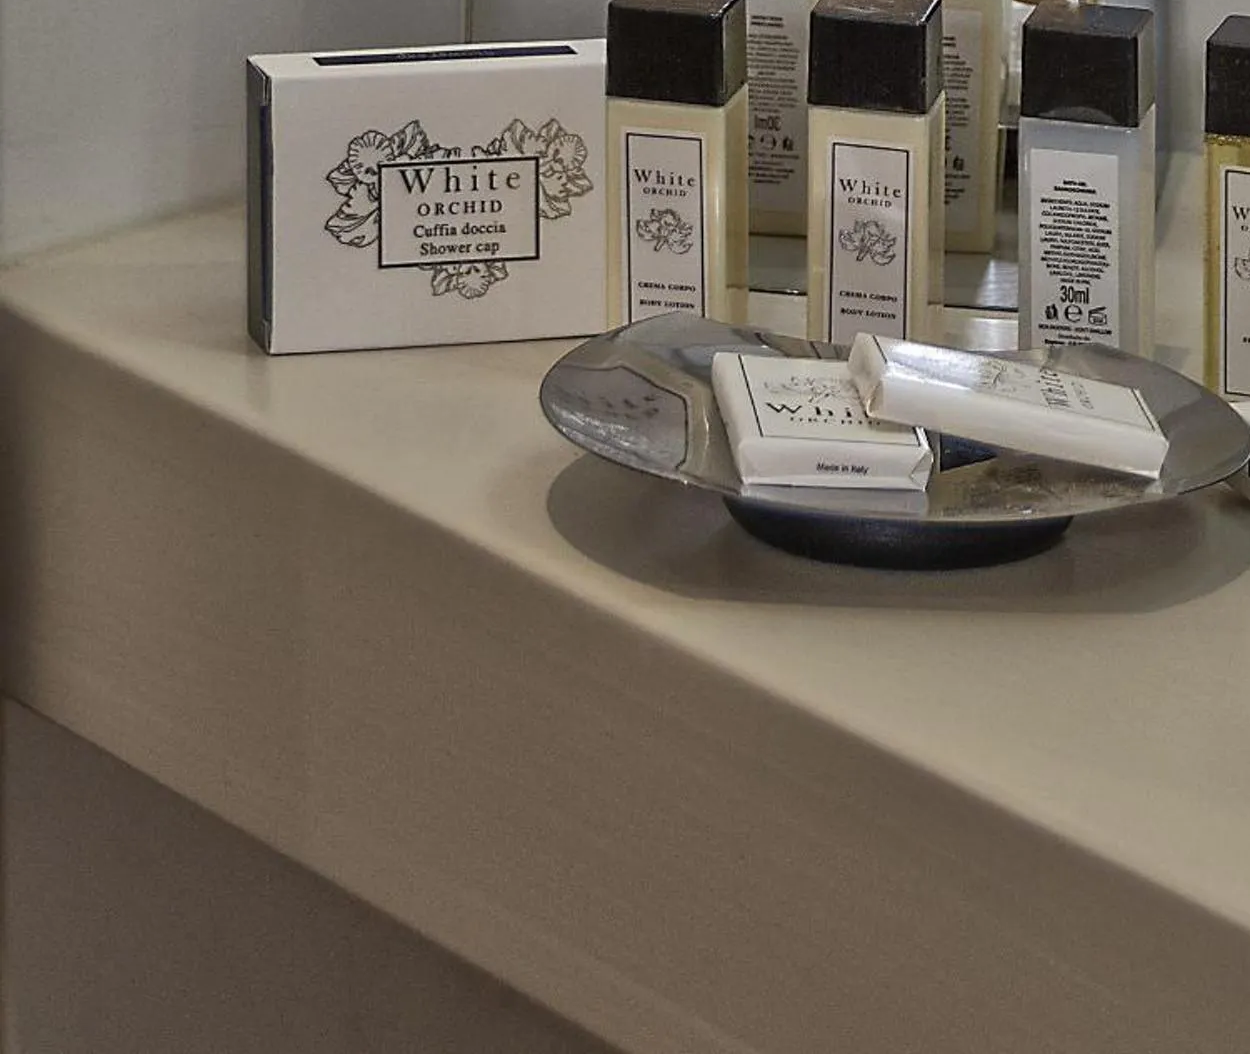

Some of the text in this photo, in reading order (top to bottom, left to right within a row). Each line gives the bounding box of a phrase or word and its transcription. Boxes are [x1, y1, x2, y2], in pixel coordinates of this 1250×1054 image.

[400, 166, 521, 194] White
[633, 168, 697, 187] White
[642, 186, 688, 197] ORCHID
[839, 178, 901, 198] White
[417, 200, 503, 217] ORCHID
[847, 197, 892, 208] ORCHID
[413, 222, 506, 238] Cuffia doccia
[420, 241, 500, 256] Shower cap
[1060, 285, 1089, 305] 30ml
